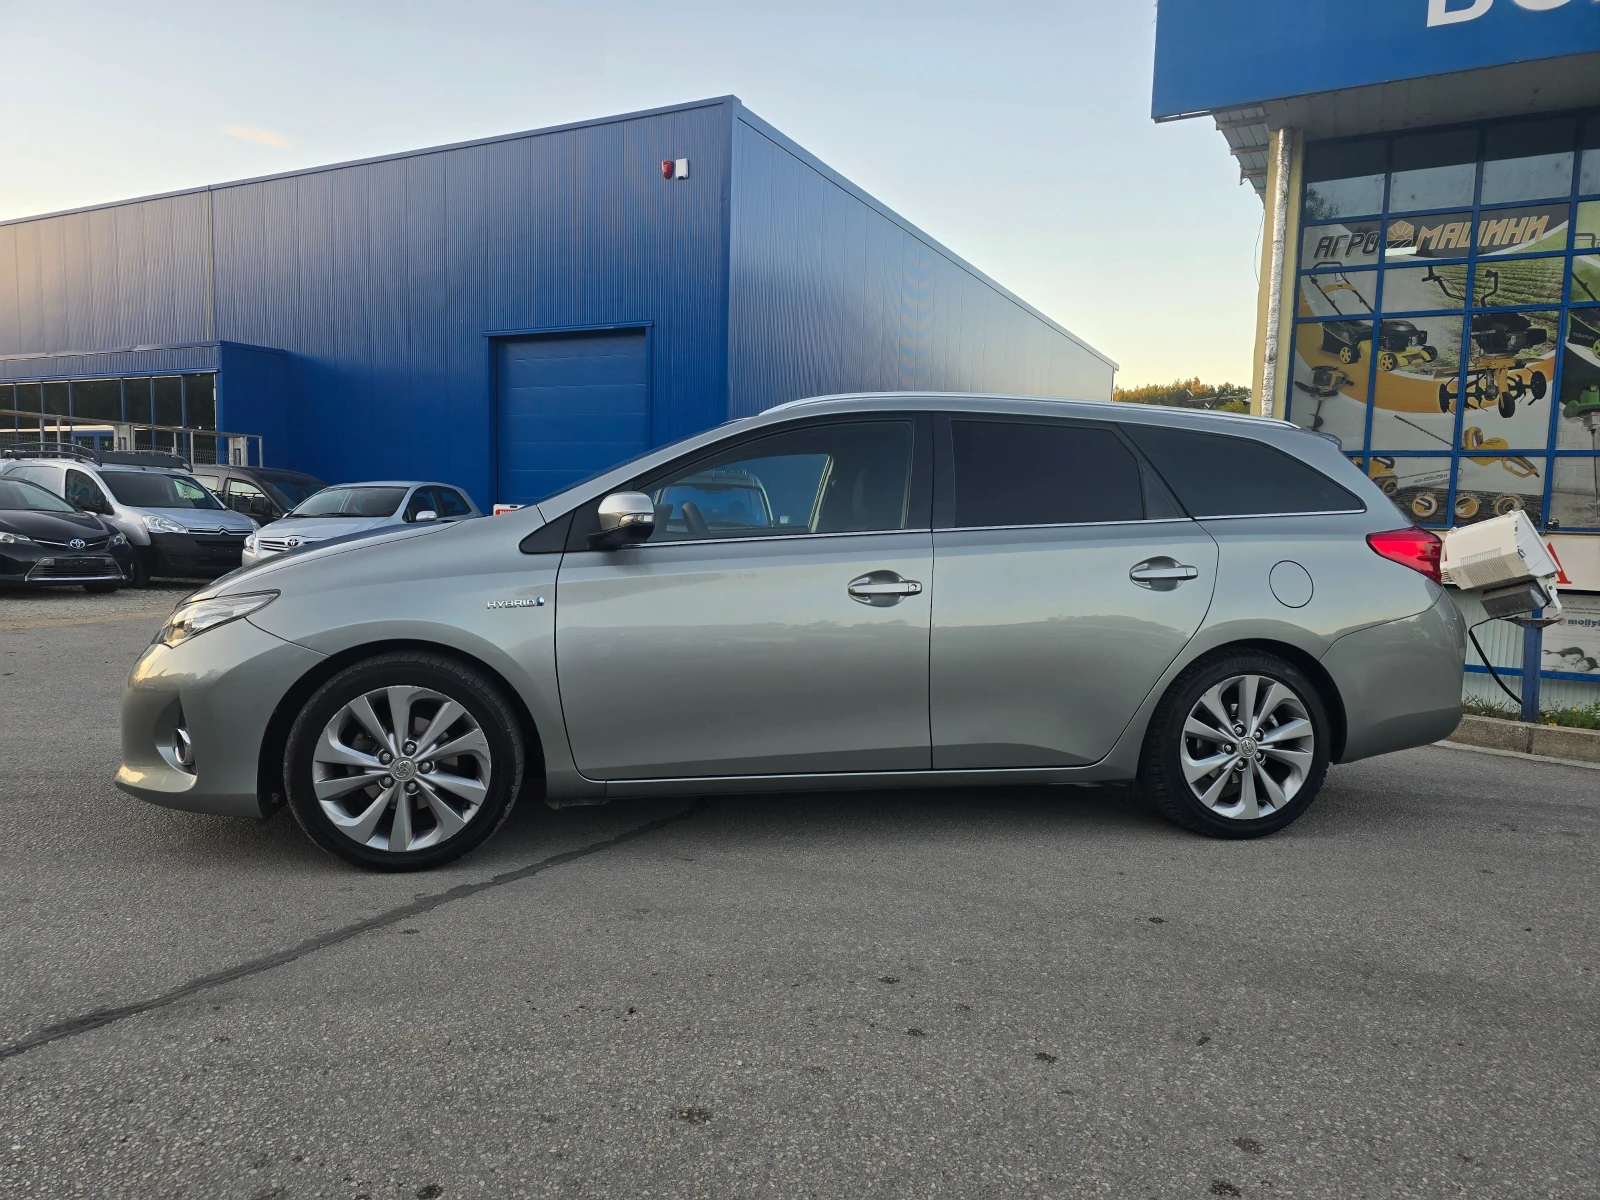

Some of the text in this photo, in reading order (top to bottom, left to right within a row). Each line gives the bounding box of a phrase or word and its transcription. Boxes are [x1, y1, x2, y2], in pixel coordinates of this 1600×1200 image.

[1313, 215, 1550, 259] АГРО МАШИНИ
[487, 599, 535, 609] HYBRID
